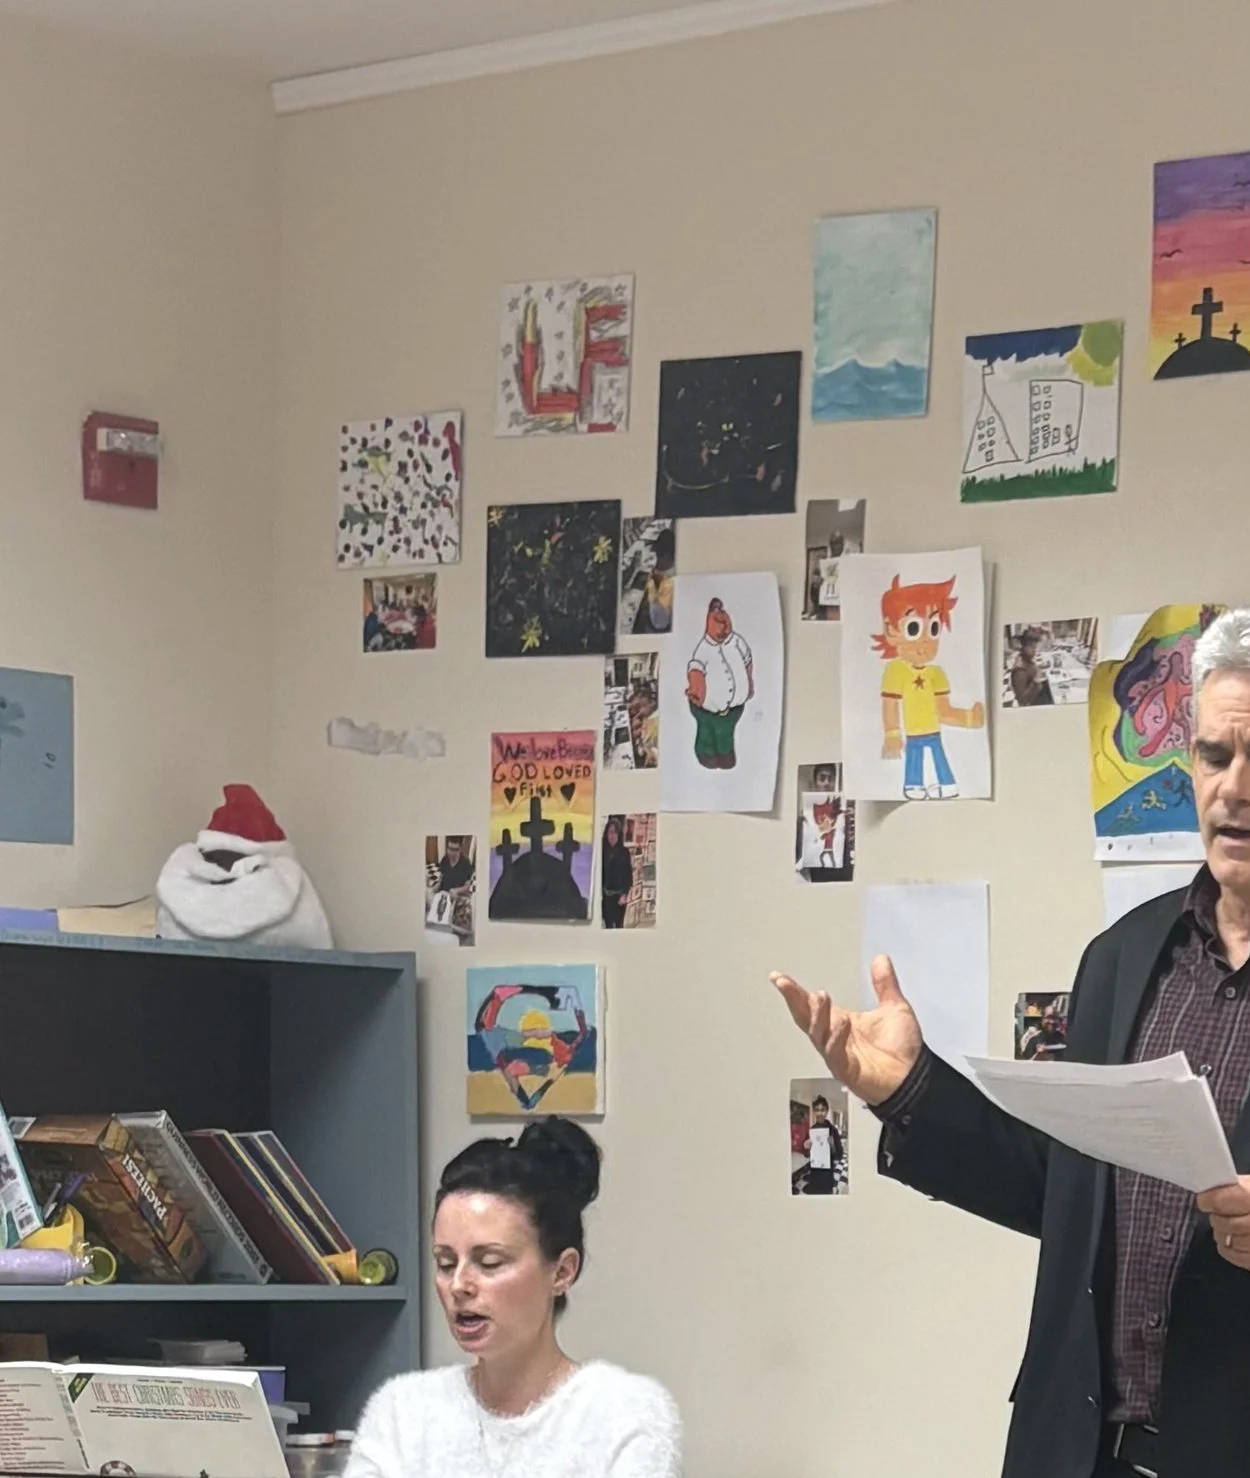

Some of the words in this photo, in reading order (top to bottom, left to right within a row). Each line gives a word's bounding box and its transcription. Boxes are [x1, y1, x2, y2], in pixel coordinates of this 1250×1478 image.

[492, 762, 538, 783] GOD
[543, 764, 591, 780] LOVED
[110, 1383, 132, 1403] BEST
